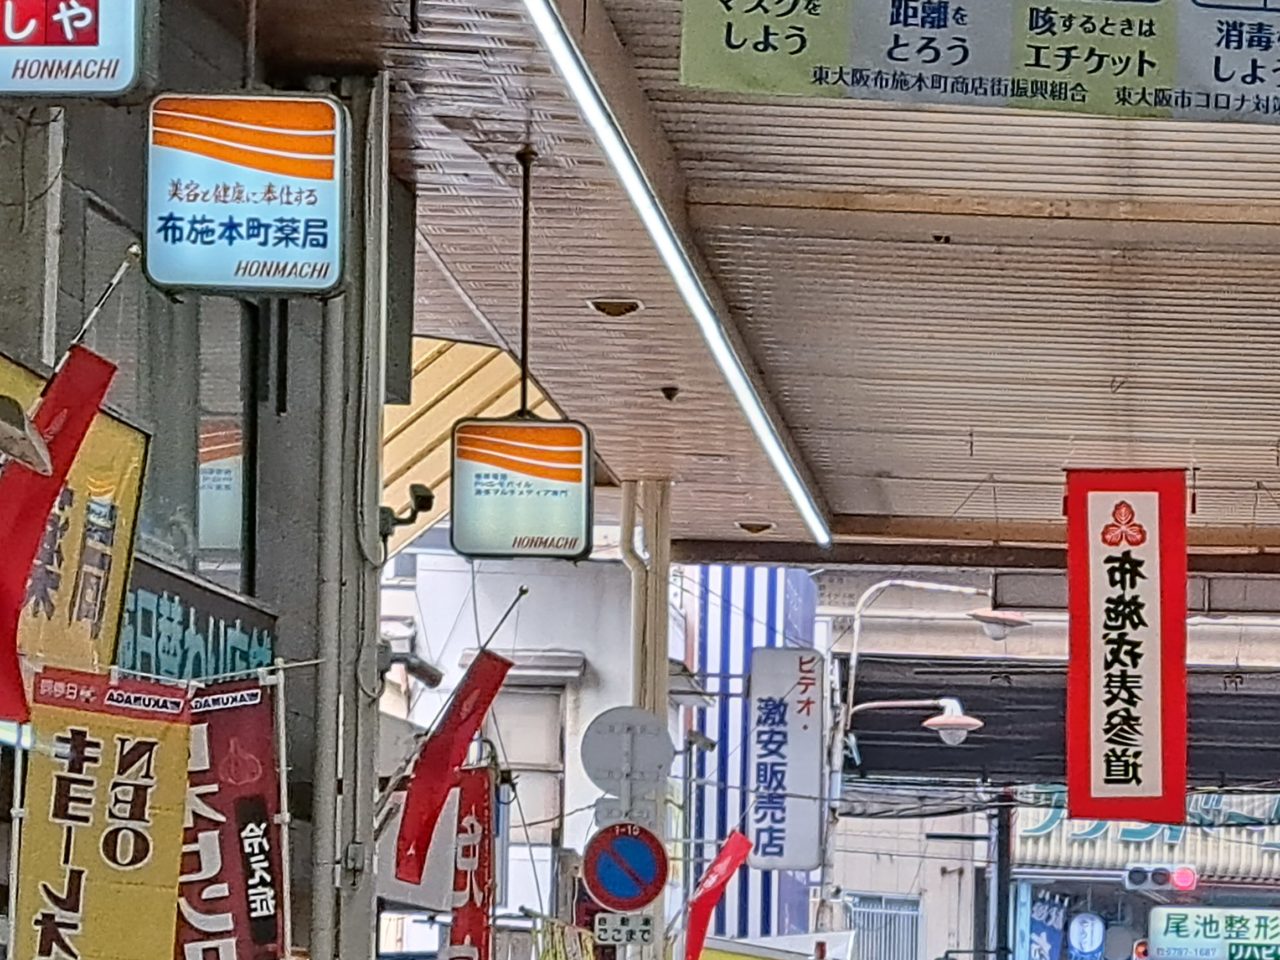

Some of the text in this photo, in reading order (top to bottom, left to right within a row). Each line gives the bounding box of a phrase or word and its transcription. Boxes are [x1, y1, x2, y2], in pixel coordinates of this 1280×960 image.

[1028, 6, 1156, 38] 咳するときは
[724, 21, 808, 56] しよう
[886, 35, 971, 67] とろう
[12, 58, 120, 81] HONMACHI
[1025, 44, 1157, 77] エチケット
[811, 65, 1089, 103] 東大阪布施本町商店街振興組合
[167, 179, 319, 207] 美容と健康に奉仕する
[157, 213, 330, 250] 布施本町薬局
[233, 259, 332, 280] HONMACHI
[512, 536, 579, 549] HONMACHI
[752, 697, 789, 858] 激安販売店
[597, 928, 652, 942] ここまで
